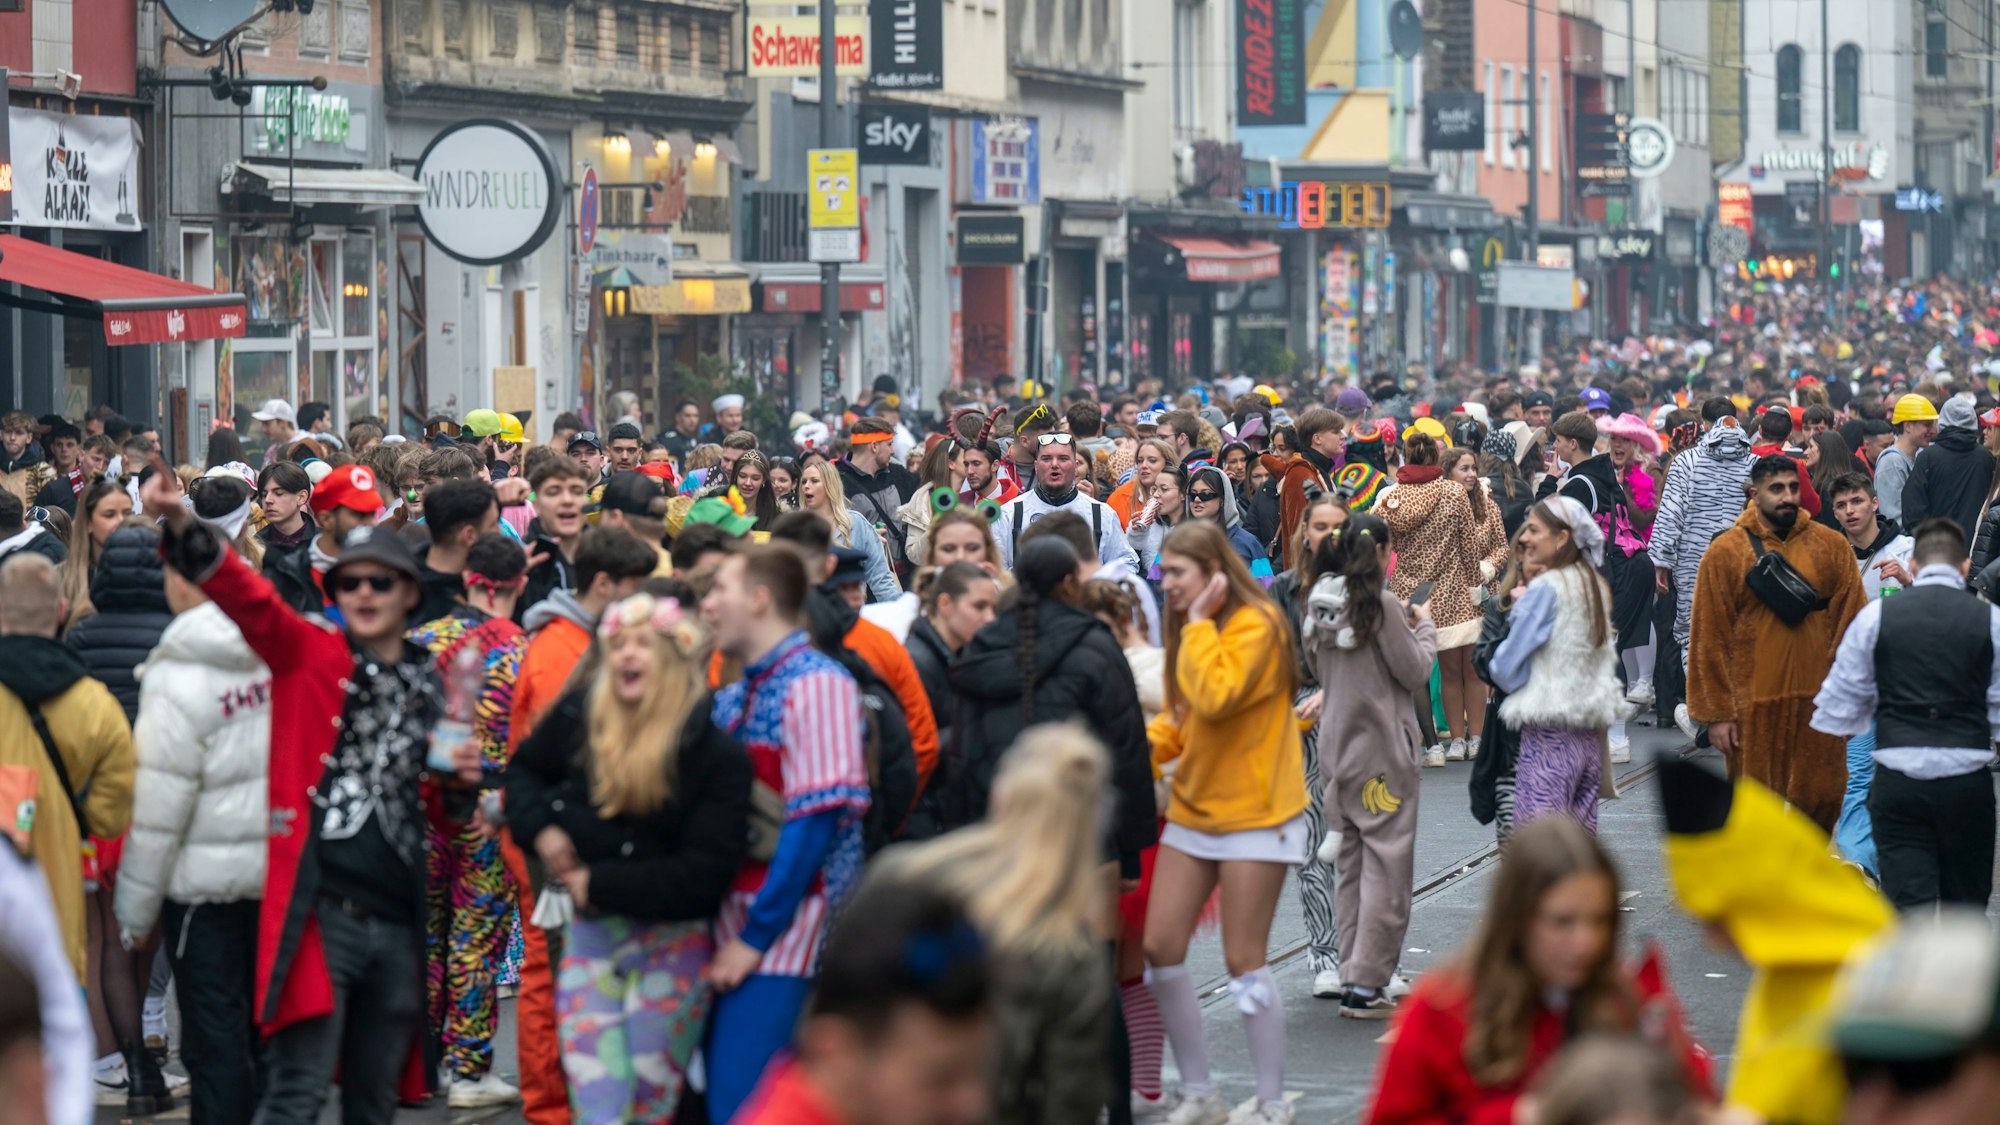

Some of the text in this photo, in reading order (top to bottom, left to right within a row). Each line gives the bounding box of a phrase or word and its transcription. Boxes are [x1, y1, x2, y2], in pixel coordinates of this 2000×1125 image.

[752, 24, 863, 67] Schawama
[894, 0, 916, 63] HILL
[865, 116, 921, 152] sky
[46, 147, 88, 183] KLLE
[44, 182, 90, 222] ALAAF!
[423, 169, 543, 210] WNDRFUEL
[1617, 234, 1651, 257] sky
